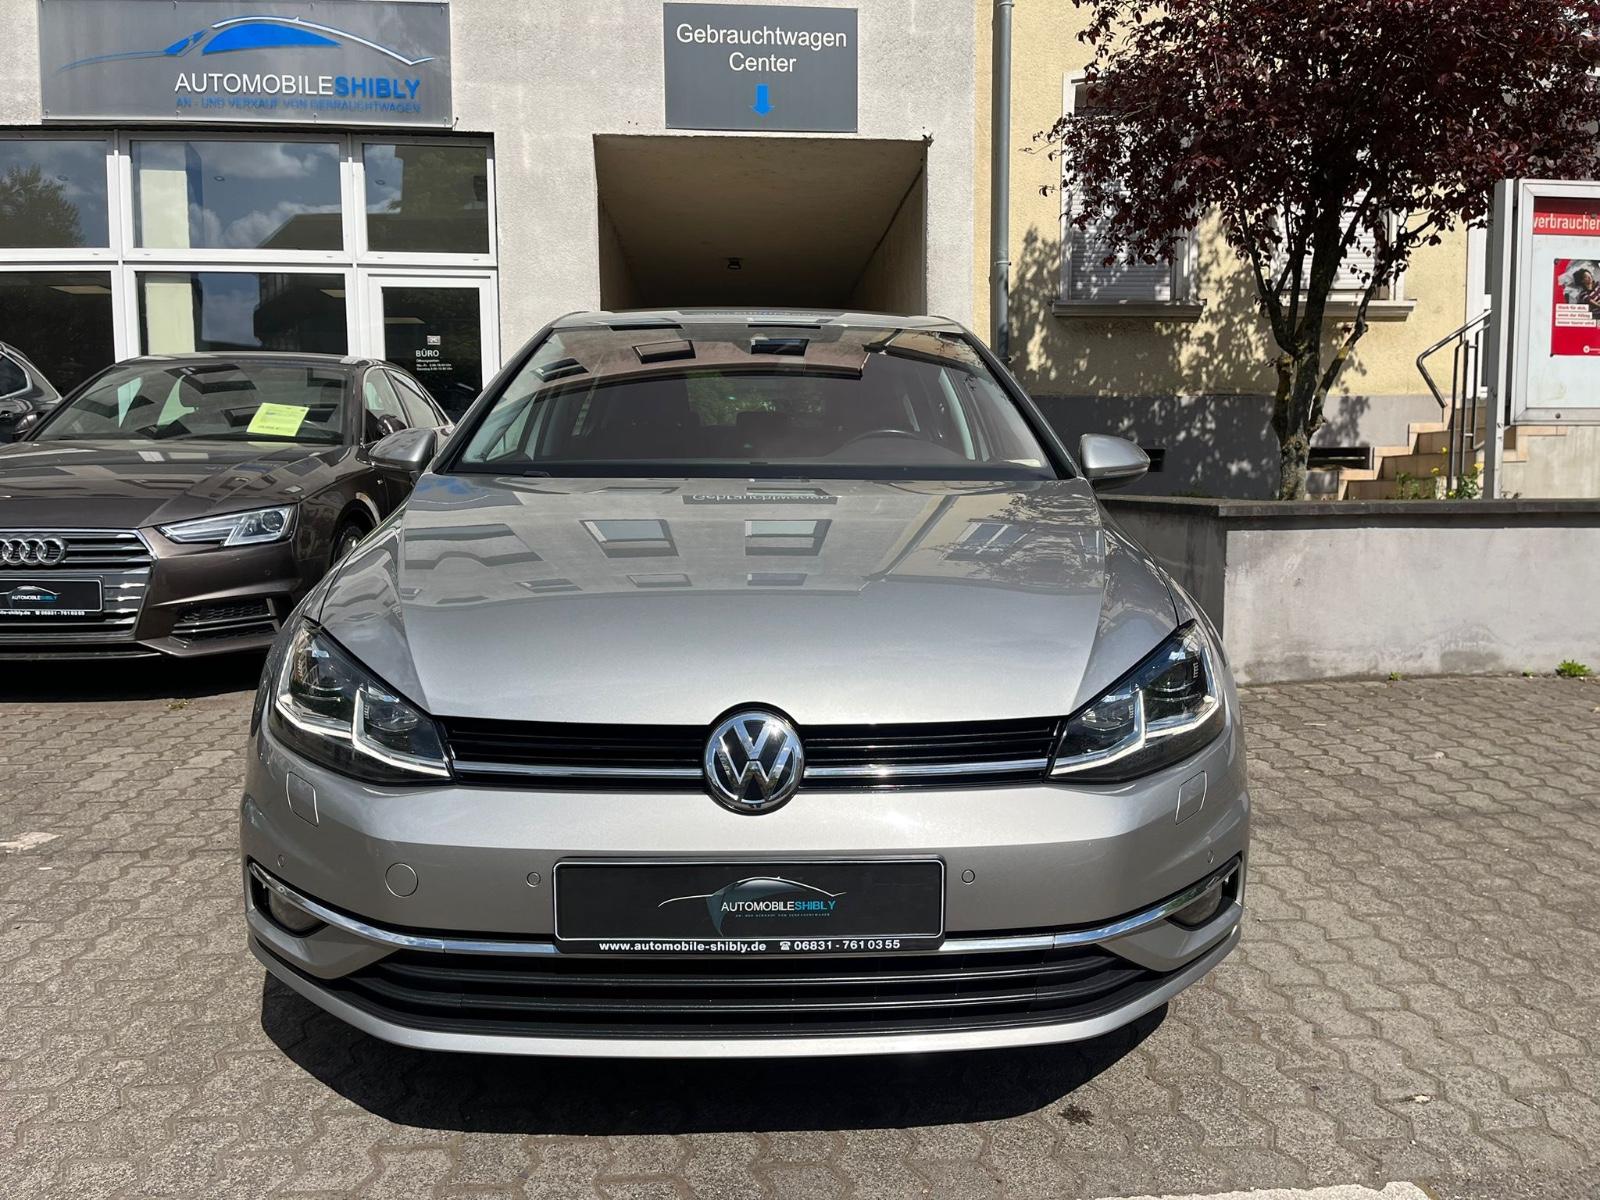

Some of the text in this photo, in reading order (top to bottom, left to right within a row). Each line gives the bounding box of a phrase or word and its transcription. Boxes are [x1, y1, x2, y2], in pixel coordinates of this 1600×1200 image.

[676, 23, 847, 51] Gebrauchtwagen
[728, 51, 797, 72] Center
[599, 941, 767, 953] www.automobile-shibly.de
[794, 940, 832, 950] 06831
